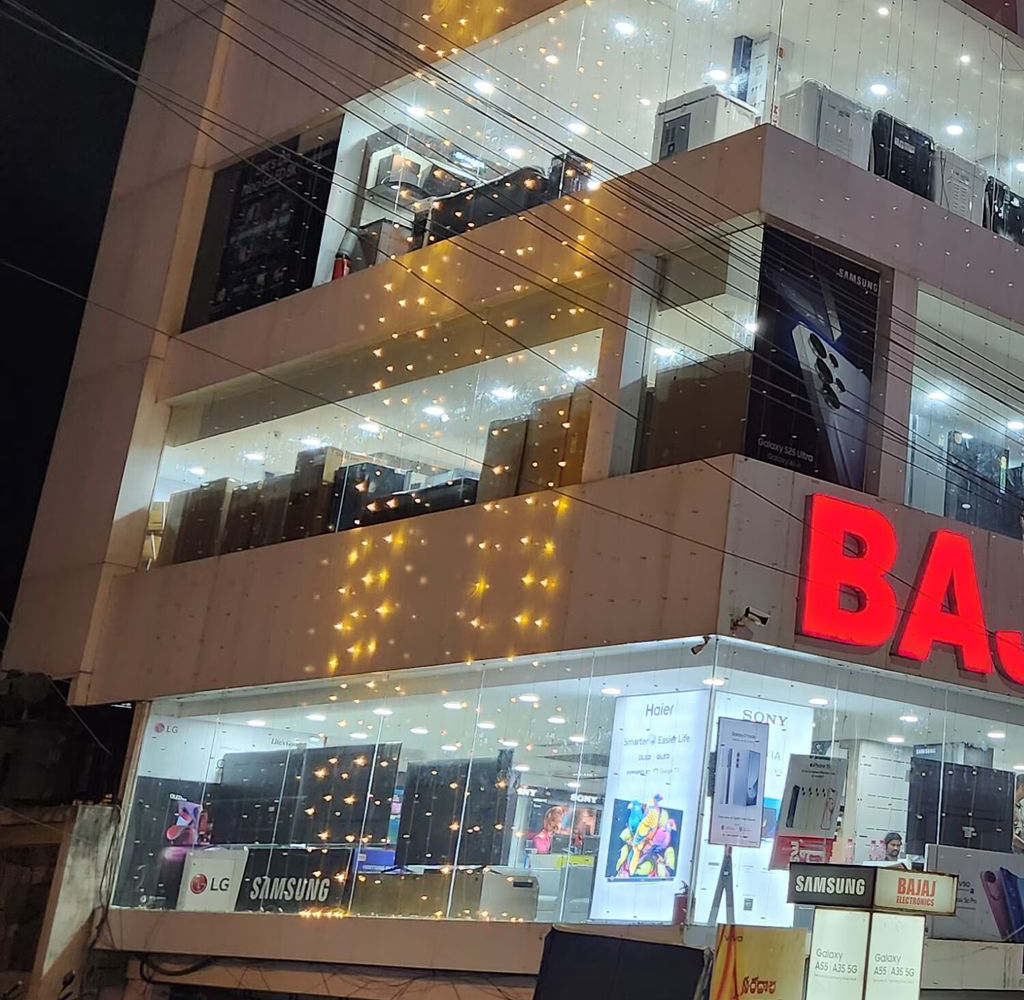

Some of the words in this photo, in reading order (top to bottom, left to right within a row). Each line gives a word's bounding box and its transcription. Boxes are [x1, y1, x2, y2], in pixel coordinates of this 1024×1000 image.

[836, 267, 878, 293] SAMSUNG
[757, 437, 784, 455] Galaxy
[645, 702, 675, 717] Haier
[742, 709, 789, 727] SONY
[166, 725, 179, 734] LG
[570, 793, 598, 803] SONY
[210, 877, 230, 892] LG
[250, 876, 330, 902] SAMSUNG
[795, 875, 866, 896] SAMSUNG
[897, 877, 937, 897] BAJAJ
[896, 895, 935, 907] ELECTRONICS
[816, 948, 843, 961] Galaxy
[874, 953, 902, 965] Galaxy
[814, 961, 829, 972] A55
[847, 964, 858, 975] 5G
[873, 966, 887, 976] A55
[905, 968, 915, 978] 5G
